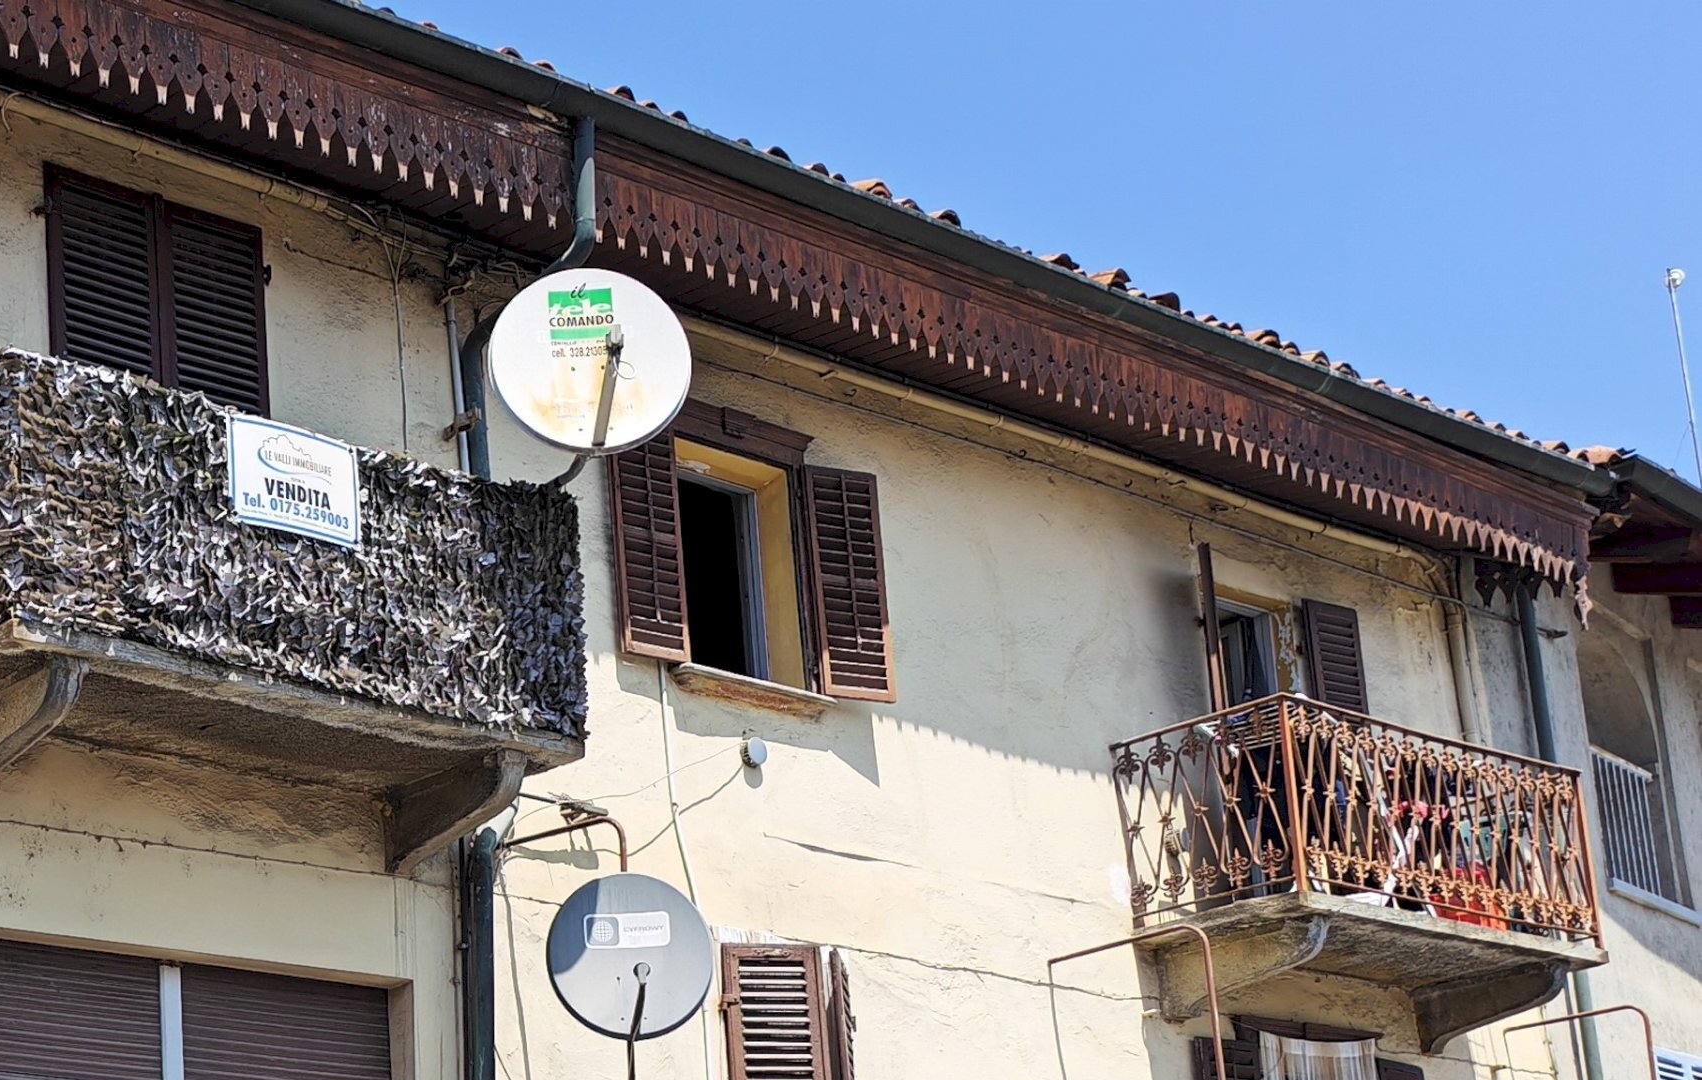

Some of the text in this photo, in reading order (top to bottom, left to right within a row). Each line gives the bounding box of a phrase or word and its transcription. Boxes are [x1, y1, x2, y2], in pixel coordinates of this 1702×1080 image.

[570, 282, 587, 298] il
[549, 298, 613, 316] tele
[549, 314, 614, 327] COMANDO
[264, 450, 332, 477] LE VALLI IMMOBILIARE
[264, 477, 331, 510] VENDITA
[242, 491, 265, 508] Tel.
[270, 497, 349, 529] 0175.259003
